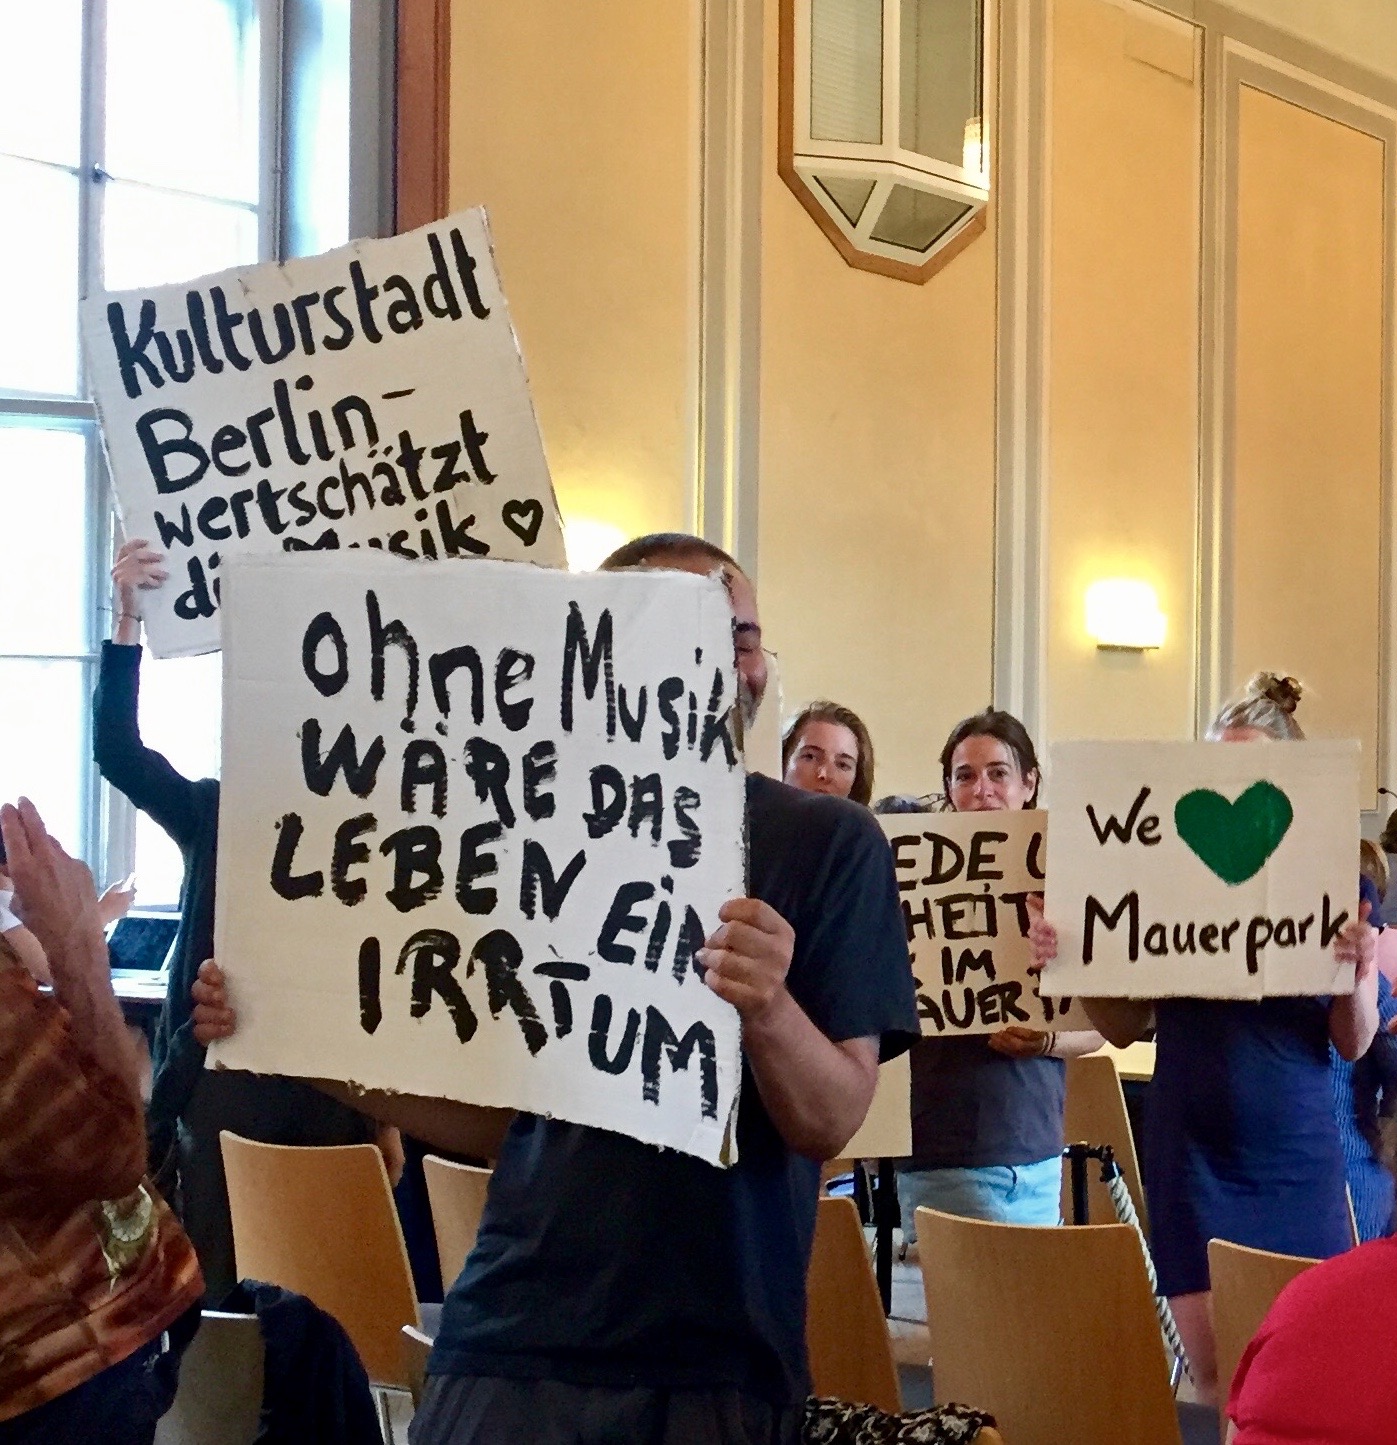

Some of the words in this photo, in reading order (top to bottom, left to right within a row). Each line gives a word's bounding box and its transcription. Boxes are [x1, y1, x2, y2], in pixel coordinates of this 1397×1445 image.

[106, 227, 492, 399] Kulturstadt
[153, 408, 500, 550] wertschätzt
[561, 600, 739, 771] Musik
[299, 715, 557, 827] WÄRE
[582, 764, 702, 869] DAS
[1085, 786, 1164, 847] We
[269, 811, 586, 921] LEBEN
[1081, 890, 1350, 976] Mauerpark
[357, 928, 719, 1121] IRRTUM
[941, 945, 997, 986] IM
